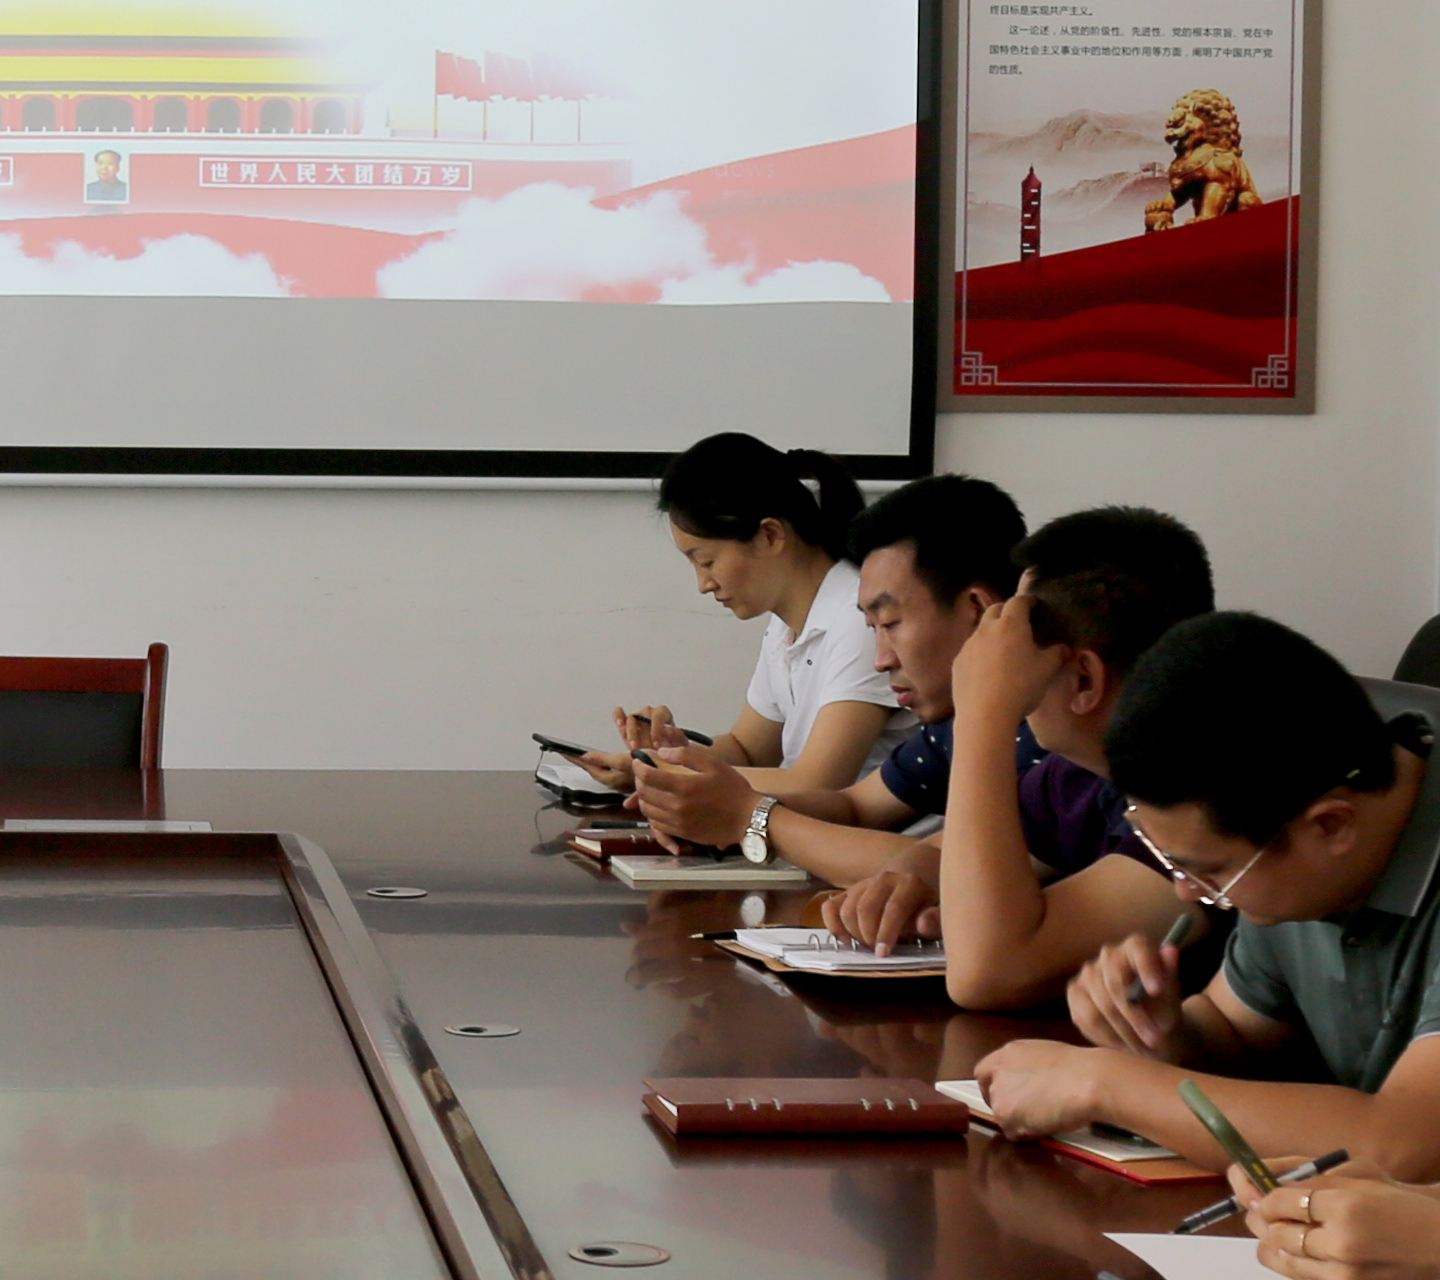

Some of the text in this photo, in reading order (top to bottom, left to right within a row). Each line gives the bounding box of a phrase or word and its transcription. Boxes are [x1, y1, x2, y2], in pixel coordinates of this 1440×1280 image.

[210, 163, 462, 186] 世界人民大团结万岁
